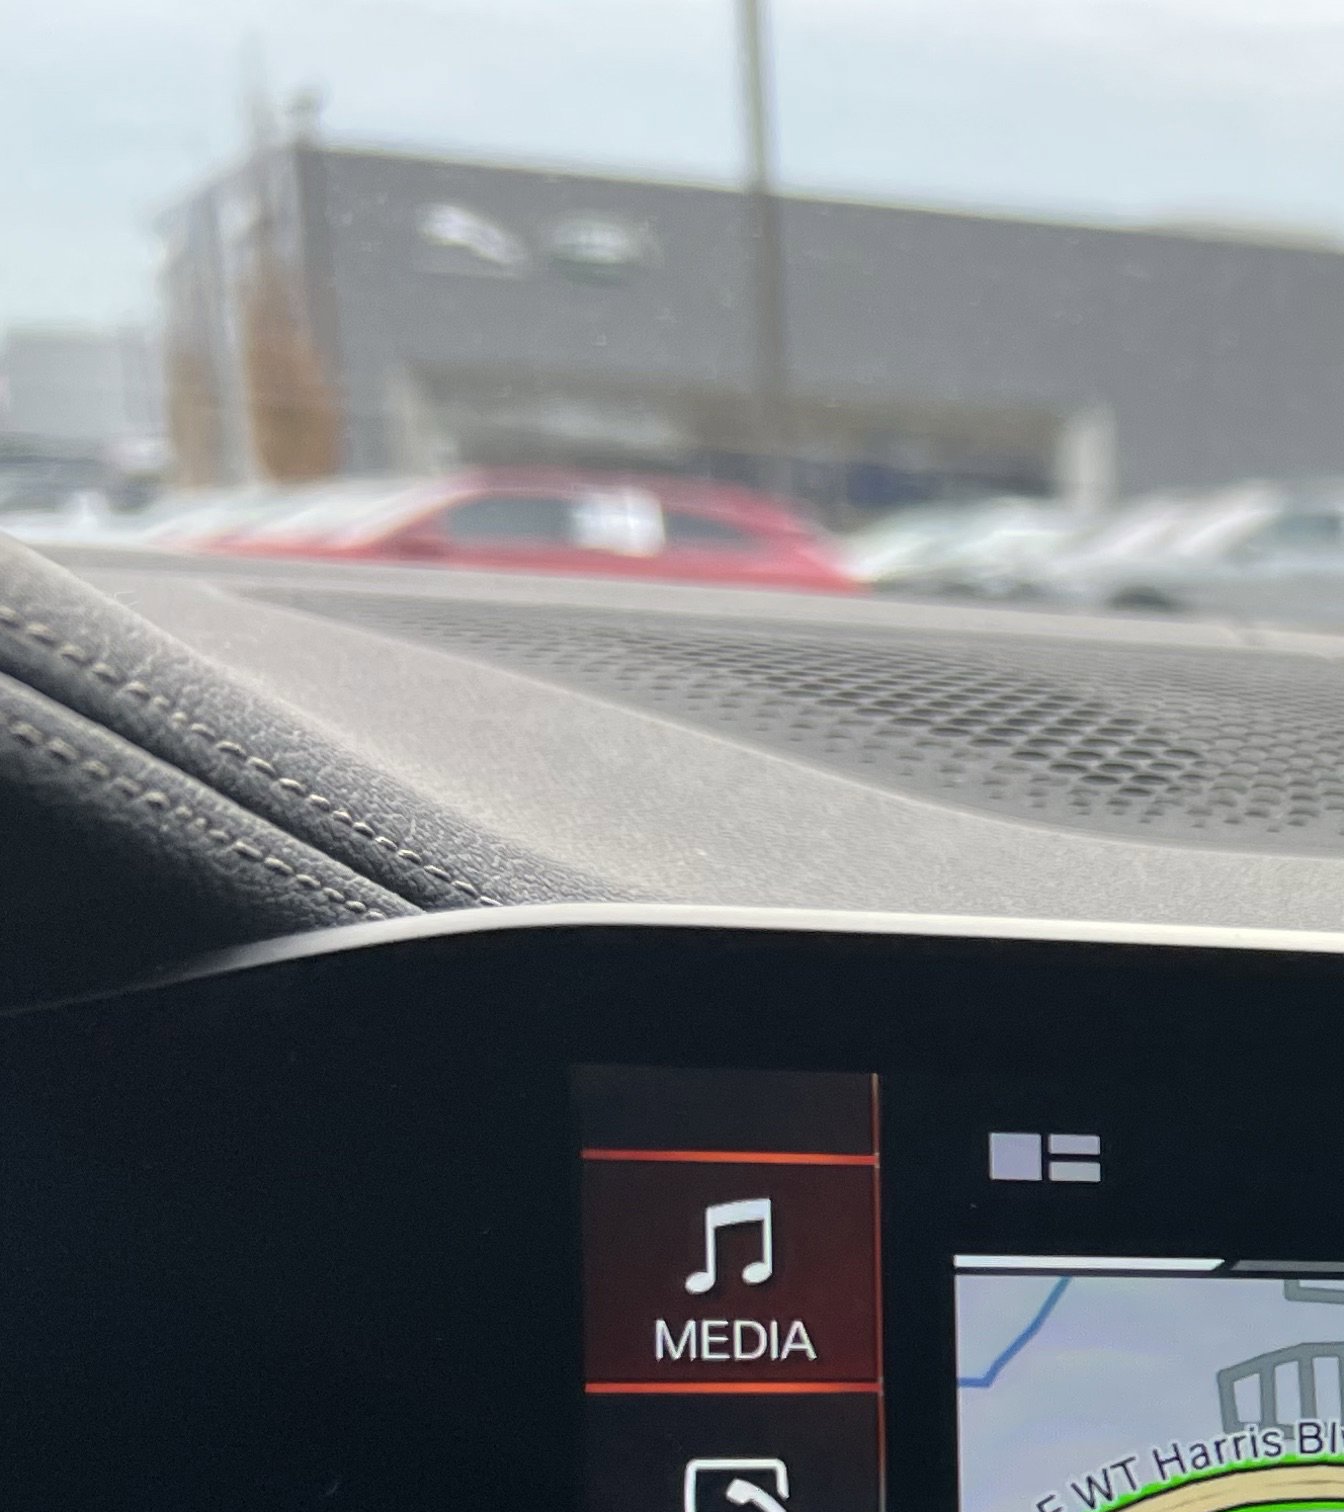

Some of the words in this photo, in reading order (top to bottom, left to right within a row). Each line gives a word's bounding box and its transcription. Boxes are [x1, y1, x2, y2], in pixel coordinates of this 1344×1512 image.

[654, 1319, 817, 1361] MEDIA
[1071, 1457, 1139, 1508] WT
[1153, 1424, 1283, 1480] Harris
